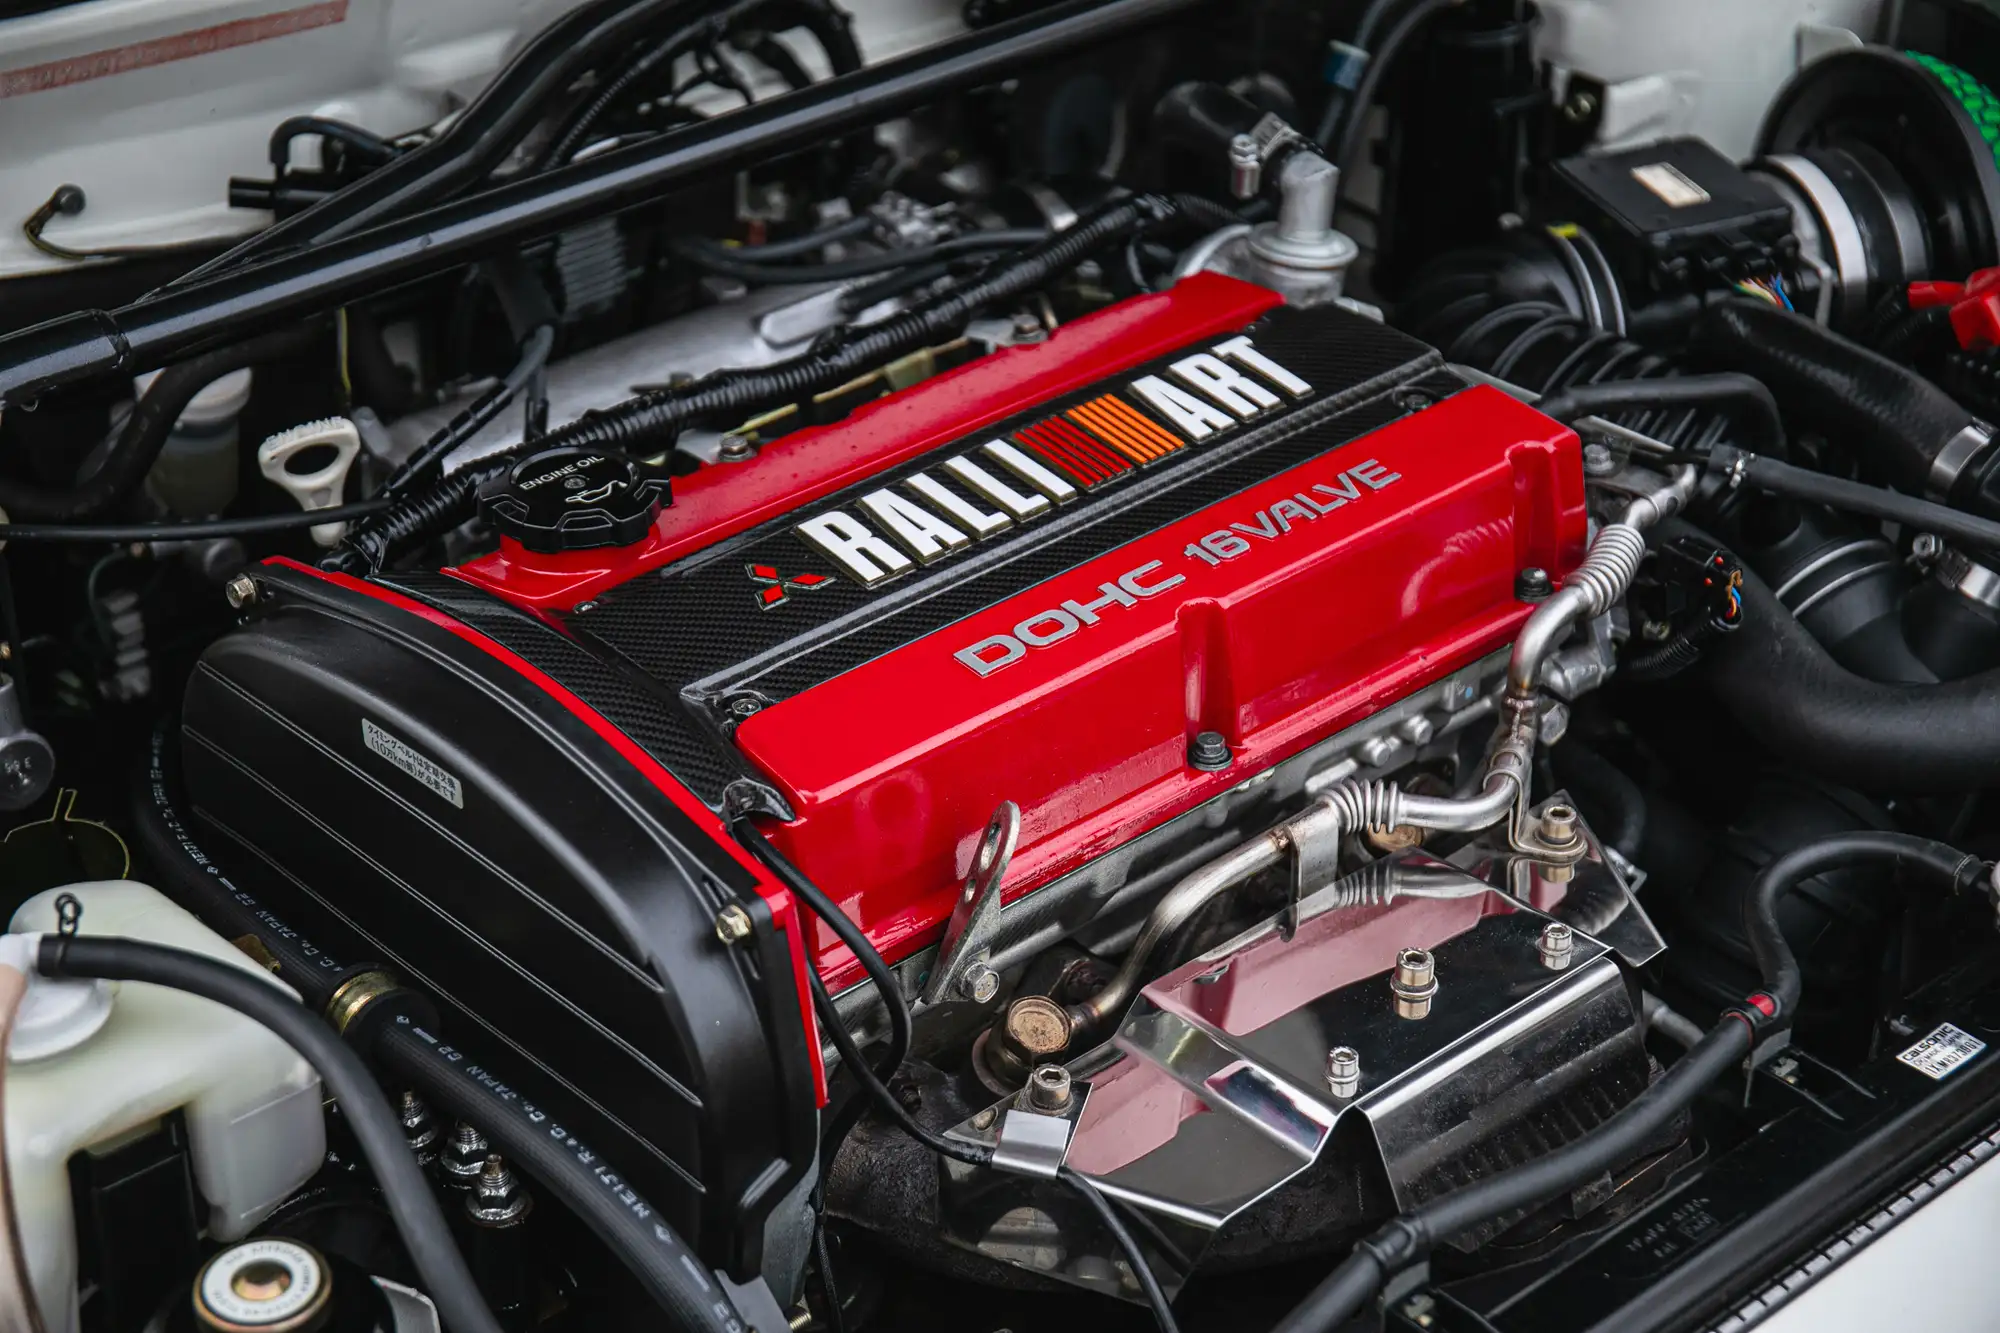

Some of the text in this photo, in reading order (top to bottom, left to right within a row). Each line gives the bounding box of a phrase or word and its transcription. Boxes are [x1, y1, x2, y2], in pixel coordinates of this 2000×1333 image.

[519, 463, 578, 491] ENGINE
[576, 456, 605, 468] OIL
[953, 559, 1186, 678] DOHC
[256, 910, 298, 938] JAPAN
[438, 1045, 463, 1061] G2
[466, 1065, 517, 1100] JAPAN
[594, 1160, 650, 1219] MEIJI
